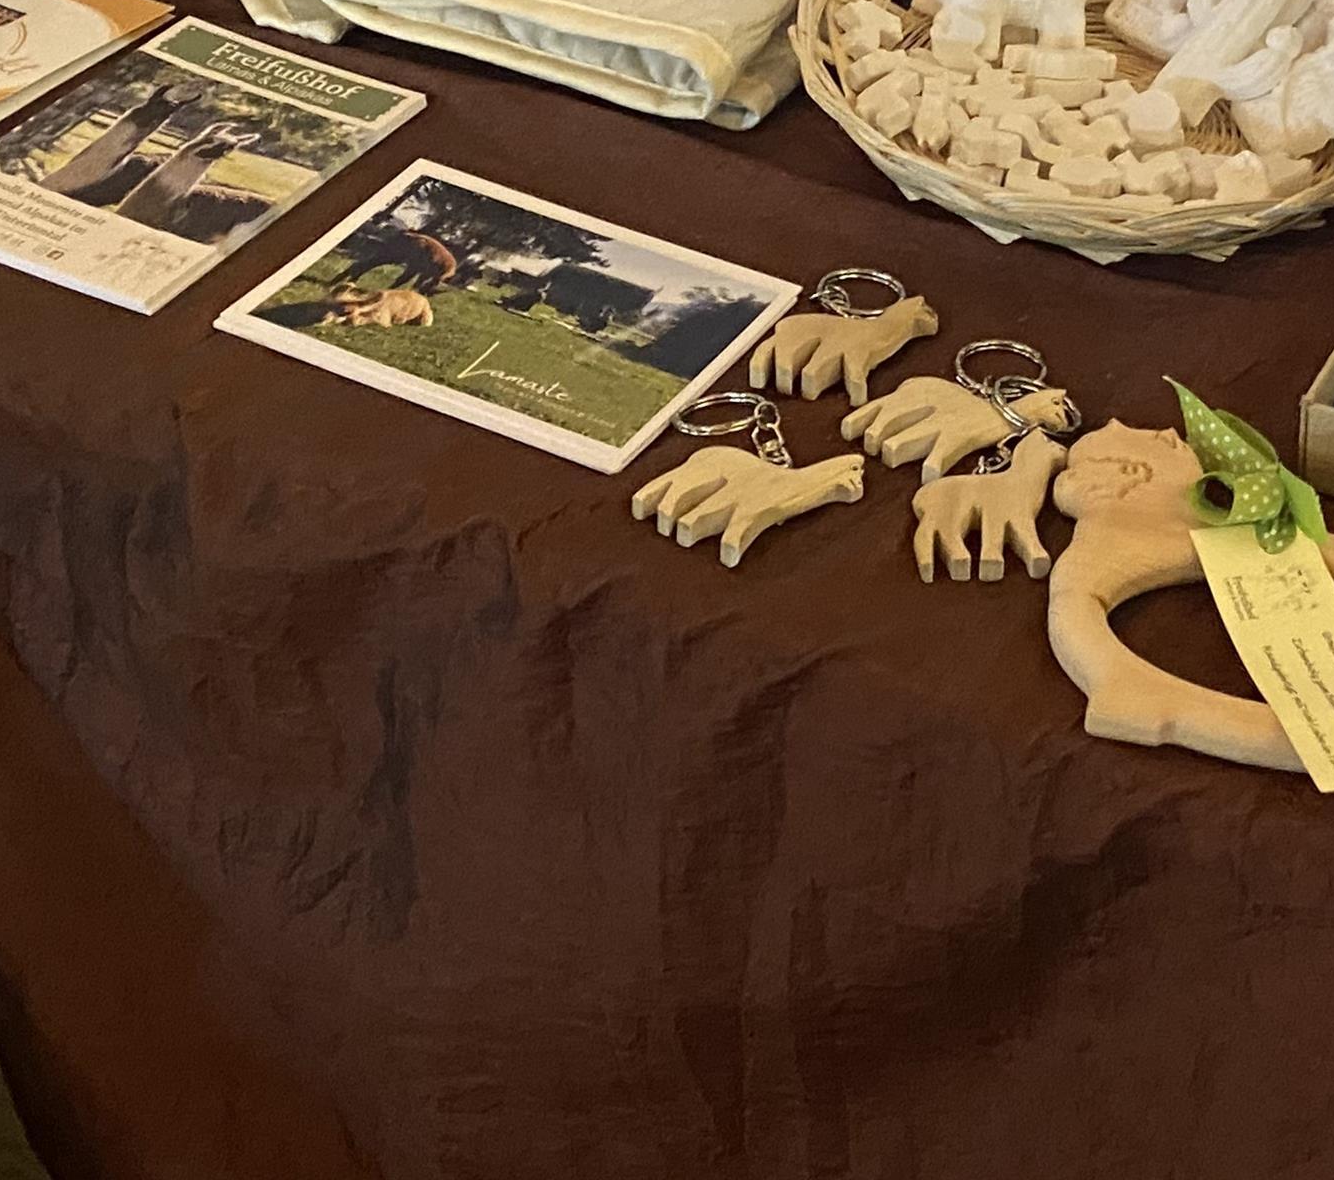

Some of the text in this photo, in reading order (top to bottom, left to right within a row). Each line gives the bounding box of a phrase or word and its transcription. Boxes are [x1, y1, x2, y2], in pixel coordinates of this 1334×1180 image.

[205, 56, 256, 82] Lamas
[211, 40, 369, 101] Freifußhof
[456, 340, 570, 402] Lamaste
